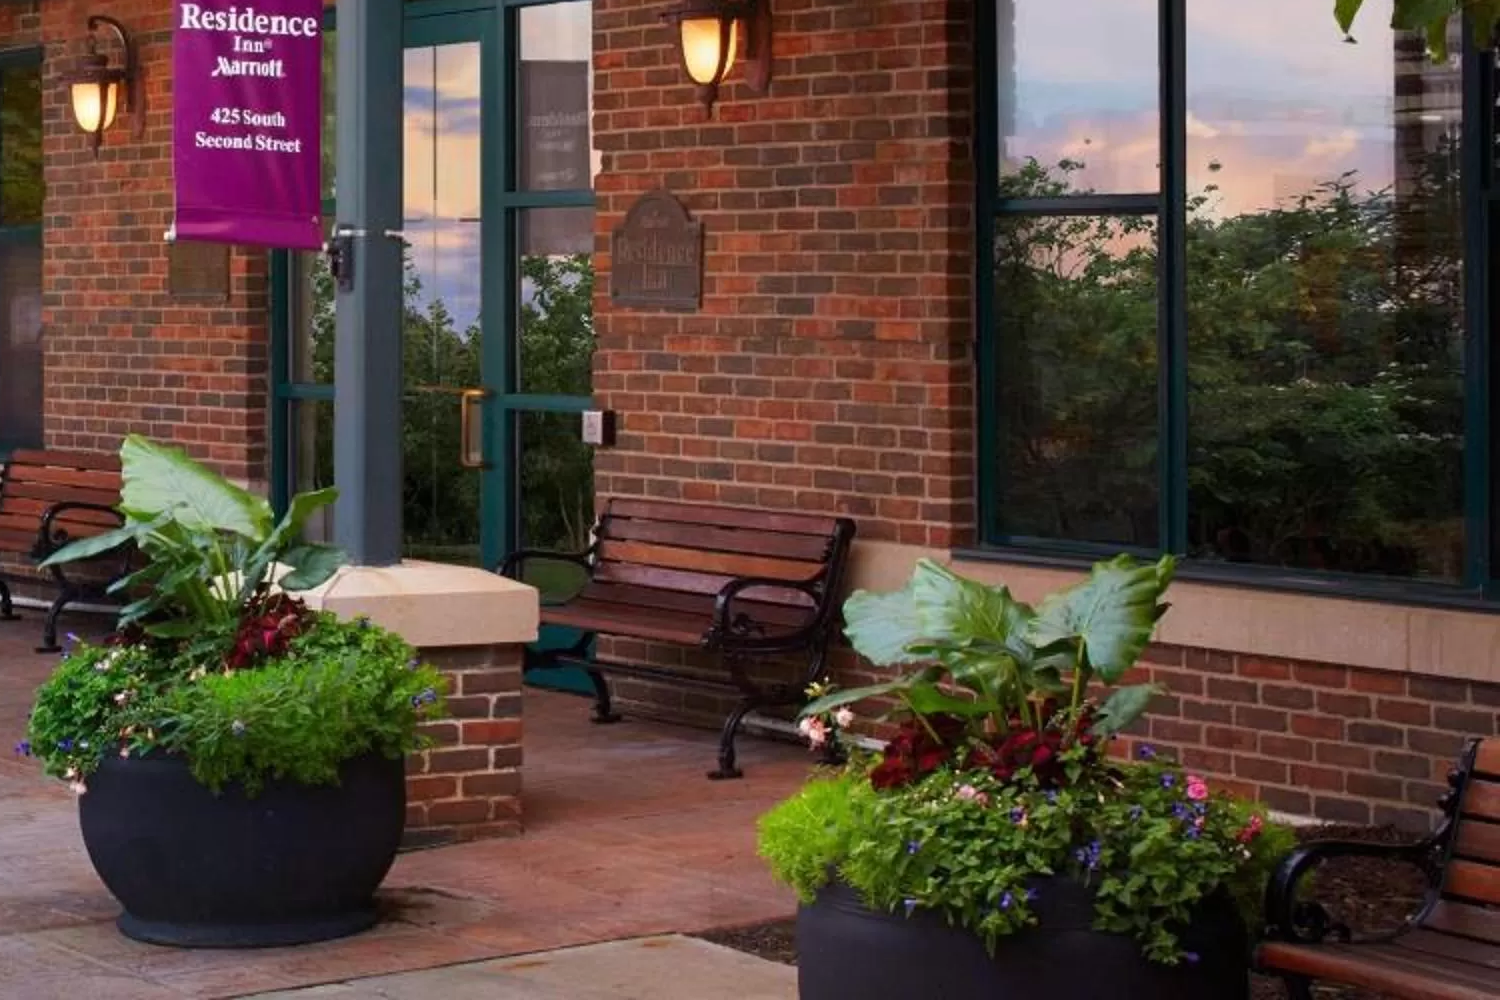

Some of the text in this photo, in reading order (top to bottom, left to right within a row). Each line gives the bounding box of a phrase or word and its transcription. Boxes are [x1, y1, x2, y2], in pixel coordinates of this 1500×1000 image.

[179, 3, 318, 37] Residence
[211, 56, 286, 77] Marriott
[210, 107, 285, 127] 425 South
[195, 131, 301, 153] Second Street
